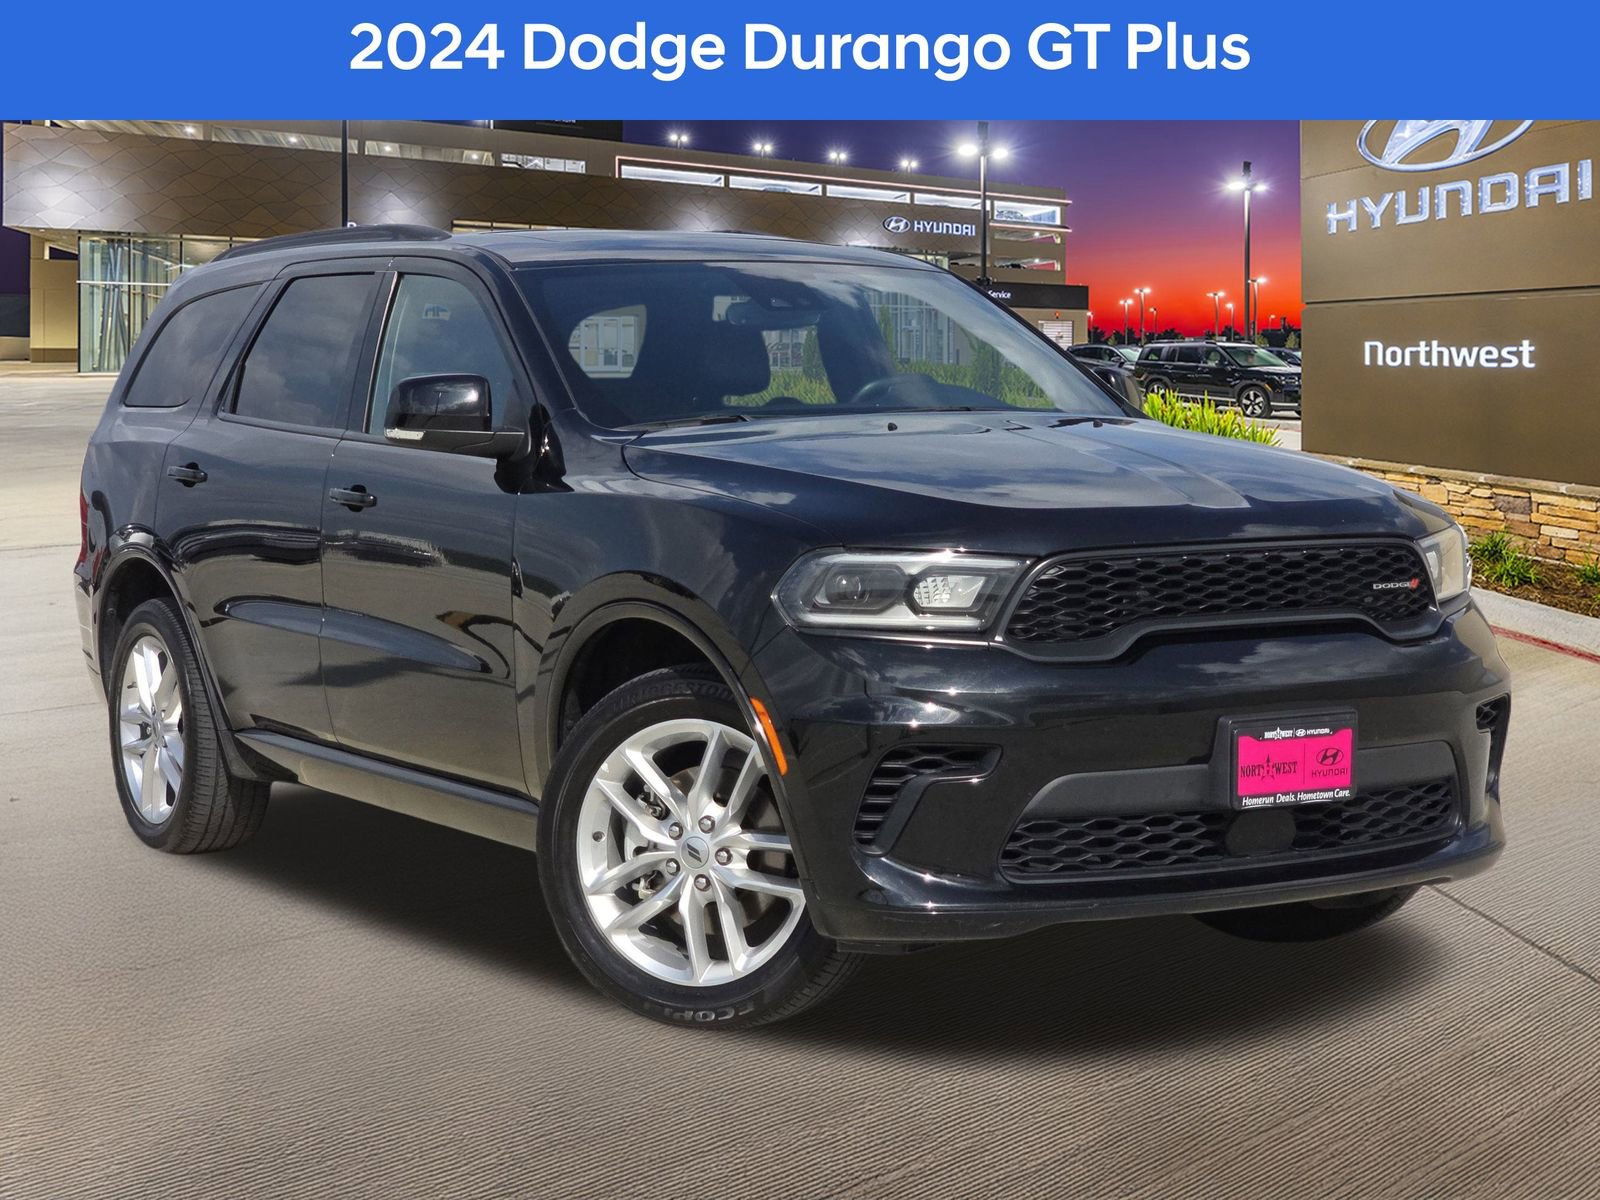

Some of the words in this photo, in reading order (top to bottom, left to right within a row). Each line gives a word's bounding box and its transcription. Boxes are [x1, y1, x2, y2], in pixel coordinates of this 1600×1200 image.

[1326, 158, 1593, 235] HYUNDAI
[913, 220, 976, 236] HYUNDAI
[988, 289, 1012, 299] Service
[1363, 339, 1537, 369] Northwest
[1311, 767, 1348, 778] HYUNDAI
[1242, 796, 1274, 806] Homerun
[1276, 792, 1297, 803] Deals.
[1297, 790, 1334, 801] Hometown
[1334, 788, 1351, 798] Care.
